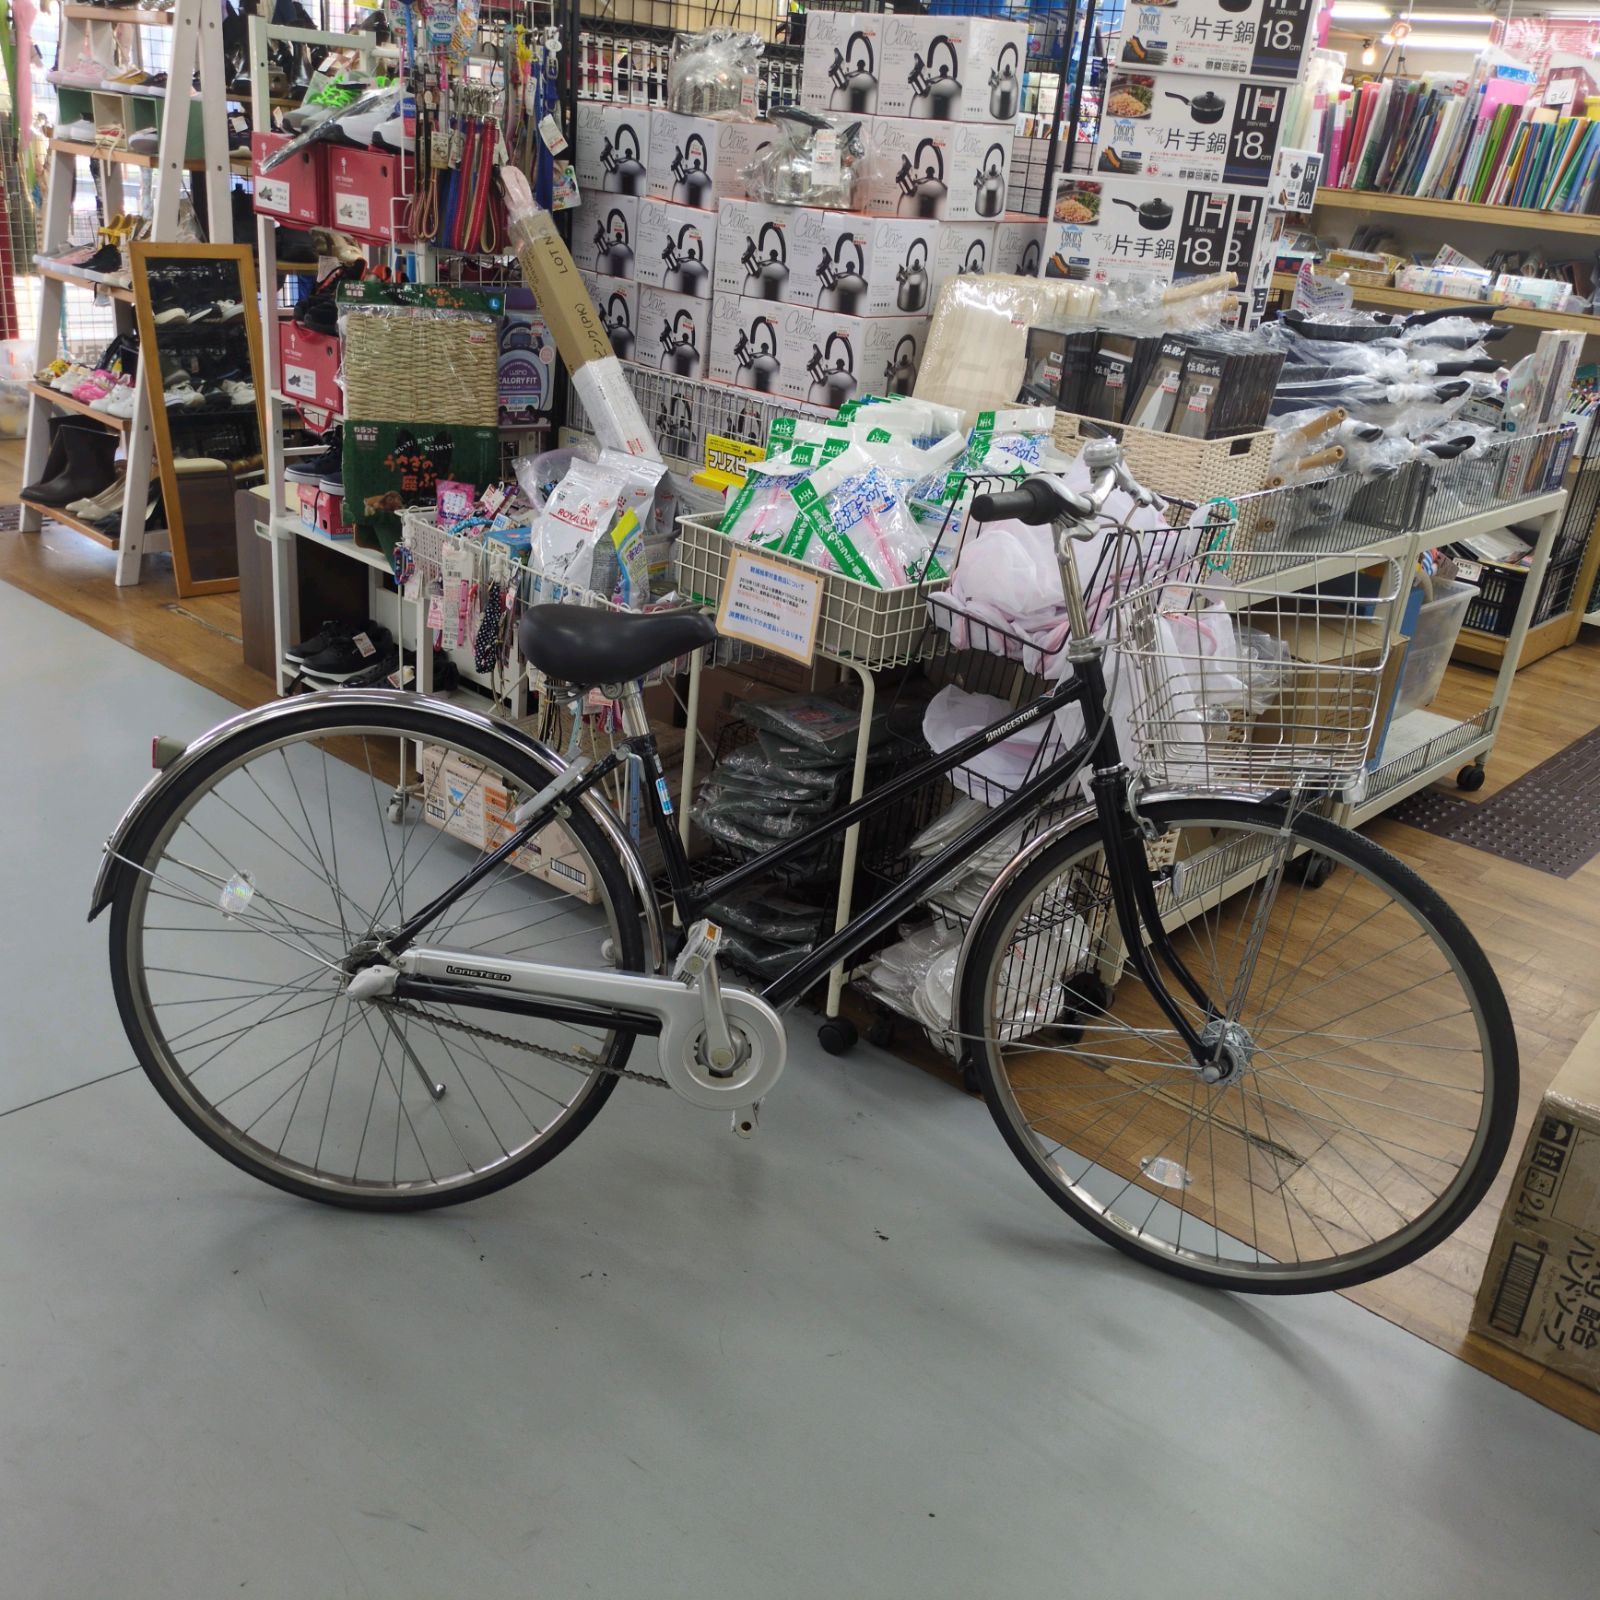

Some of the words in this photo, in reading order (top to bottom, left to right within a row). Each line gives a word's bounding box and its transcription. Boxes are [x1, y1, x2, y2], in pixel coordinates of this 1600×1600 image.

[1190, 16, 1256, 45] 片手鍋
[1164, 128, 1228, 155] 片手鍋
[1188, 193, 1230, 230] IH
[1112, 234, 1176, 261] 片手鍋
[557, 508, 579, 524] ROYAL
[985, 706, 1040, 743] BRIDGESTONE
[1544, 1235, 1597, 1352] ハンドソープ
